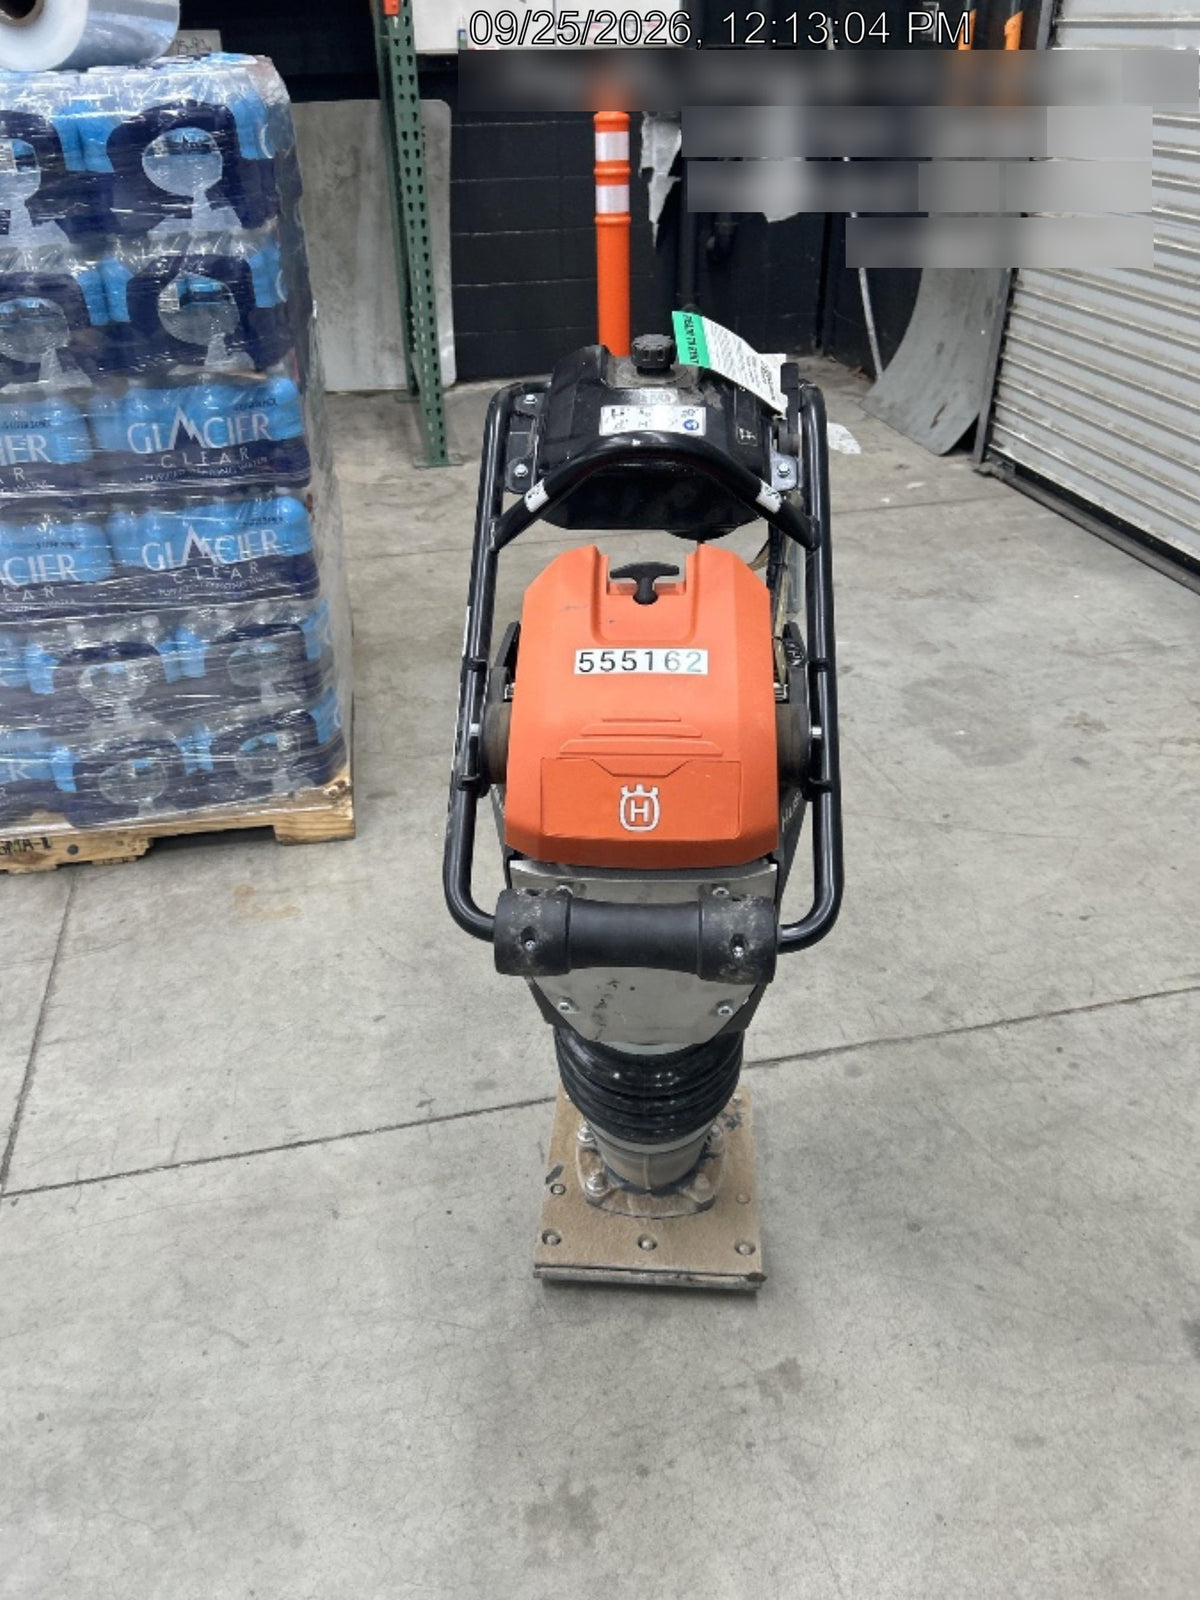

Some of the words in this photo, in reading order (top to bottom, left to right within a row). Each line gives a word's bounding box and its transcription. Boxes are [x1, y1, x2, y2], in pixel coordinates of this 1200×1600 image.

[127, 405, 273, 454] GLACIER
[161, 446, 249, 469] CLEAR
[142, 525, 281, 572] GLACIER
[0, 554, 81, 588] CIER
[173, 560, 259, 584] CLEAR
[578, 650, 703, 673] 555162
